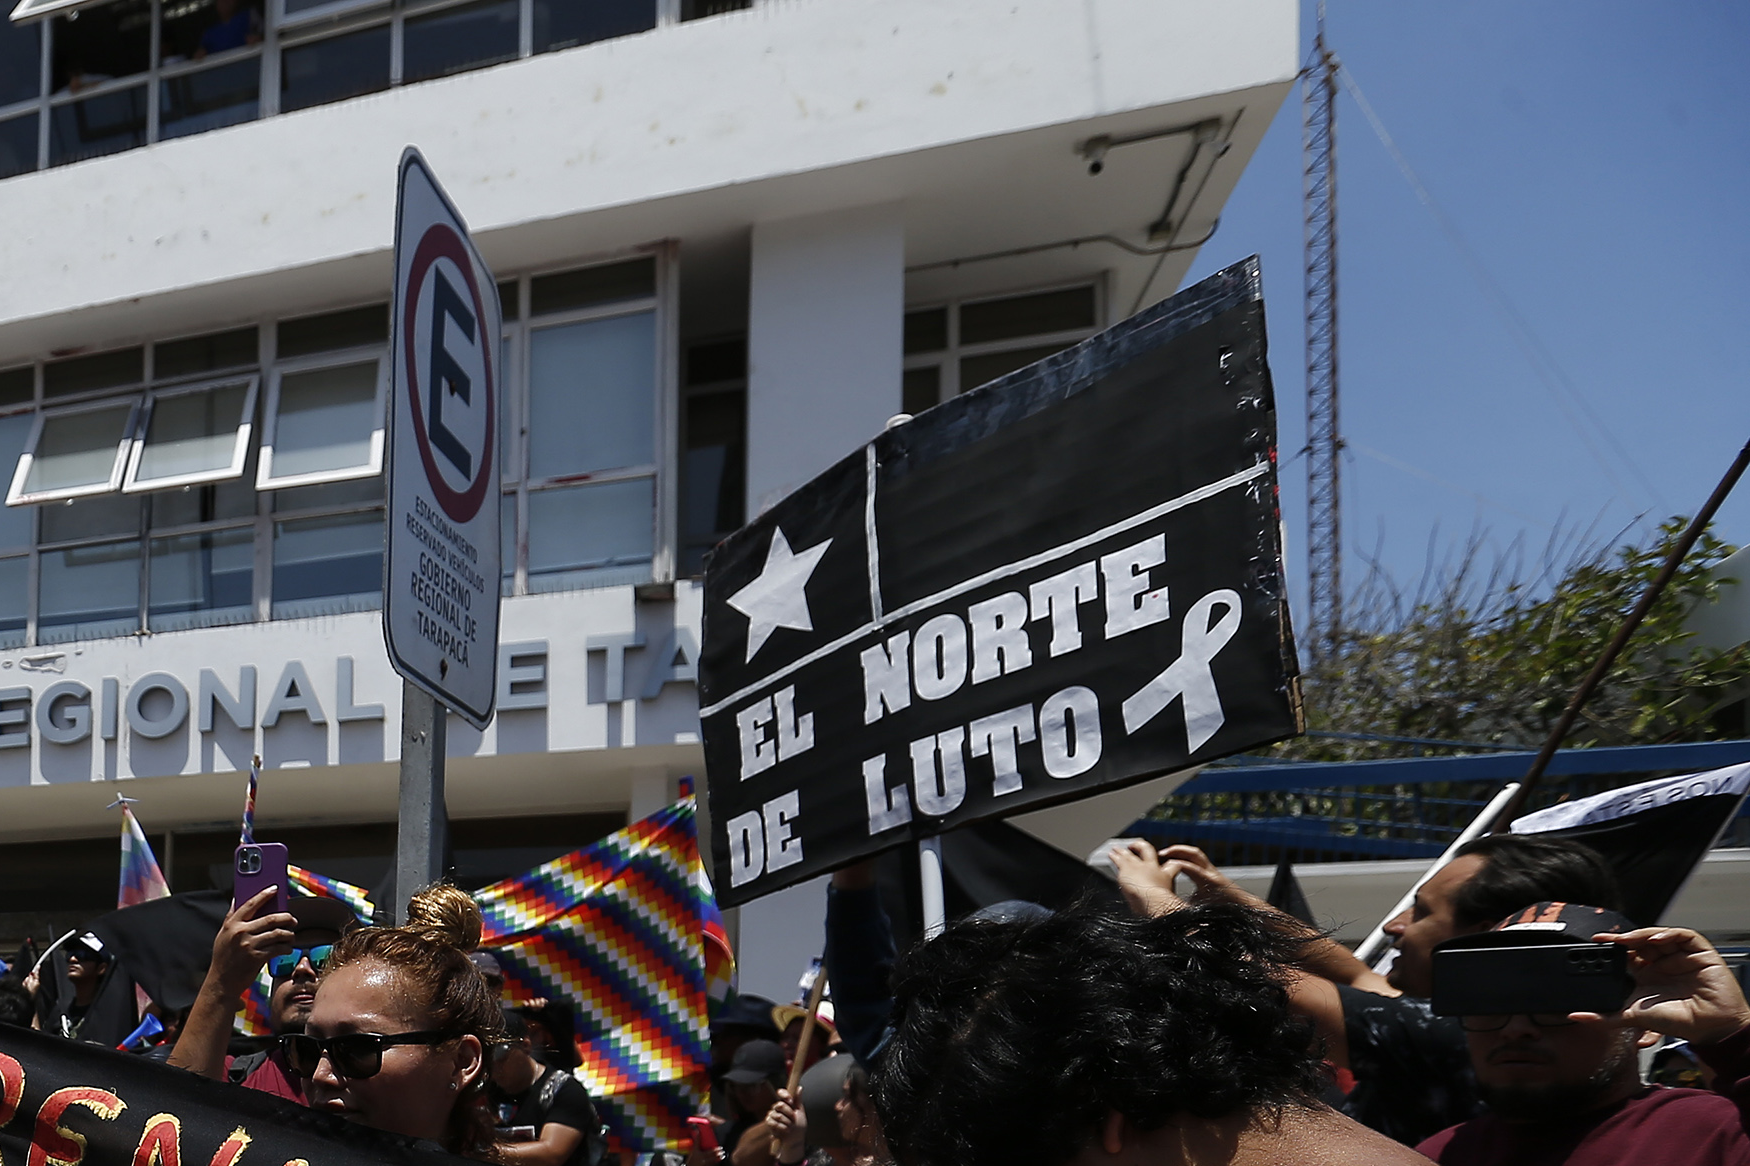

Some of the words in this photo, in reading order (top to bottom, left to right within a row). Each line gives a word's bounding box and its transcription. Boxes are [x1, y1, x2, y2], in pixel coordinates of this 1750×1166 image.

[429, 265, 476, 482] E
[406, 512, 447, 561] RESERVADO
[448, 549, 485, 593] VEHÍCULOS
[415, 496, 478, 564] ESTACIONAMIENTO
[410, 571, 461, 631] REGIONAL
[464, 614, 477, 642] DE
[419, 551, 472, 611] GOBIERNO
[417, 610, 469, 668] TARAPACÁ
[497, 638, 549, 712] E
[736, 684, 815, 782] EL
[860, 533, 1170, 725] NORTE
[726, 789, 804, 888] DE
[862, 685, 1103, 836] LUTO
